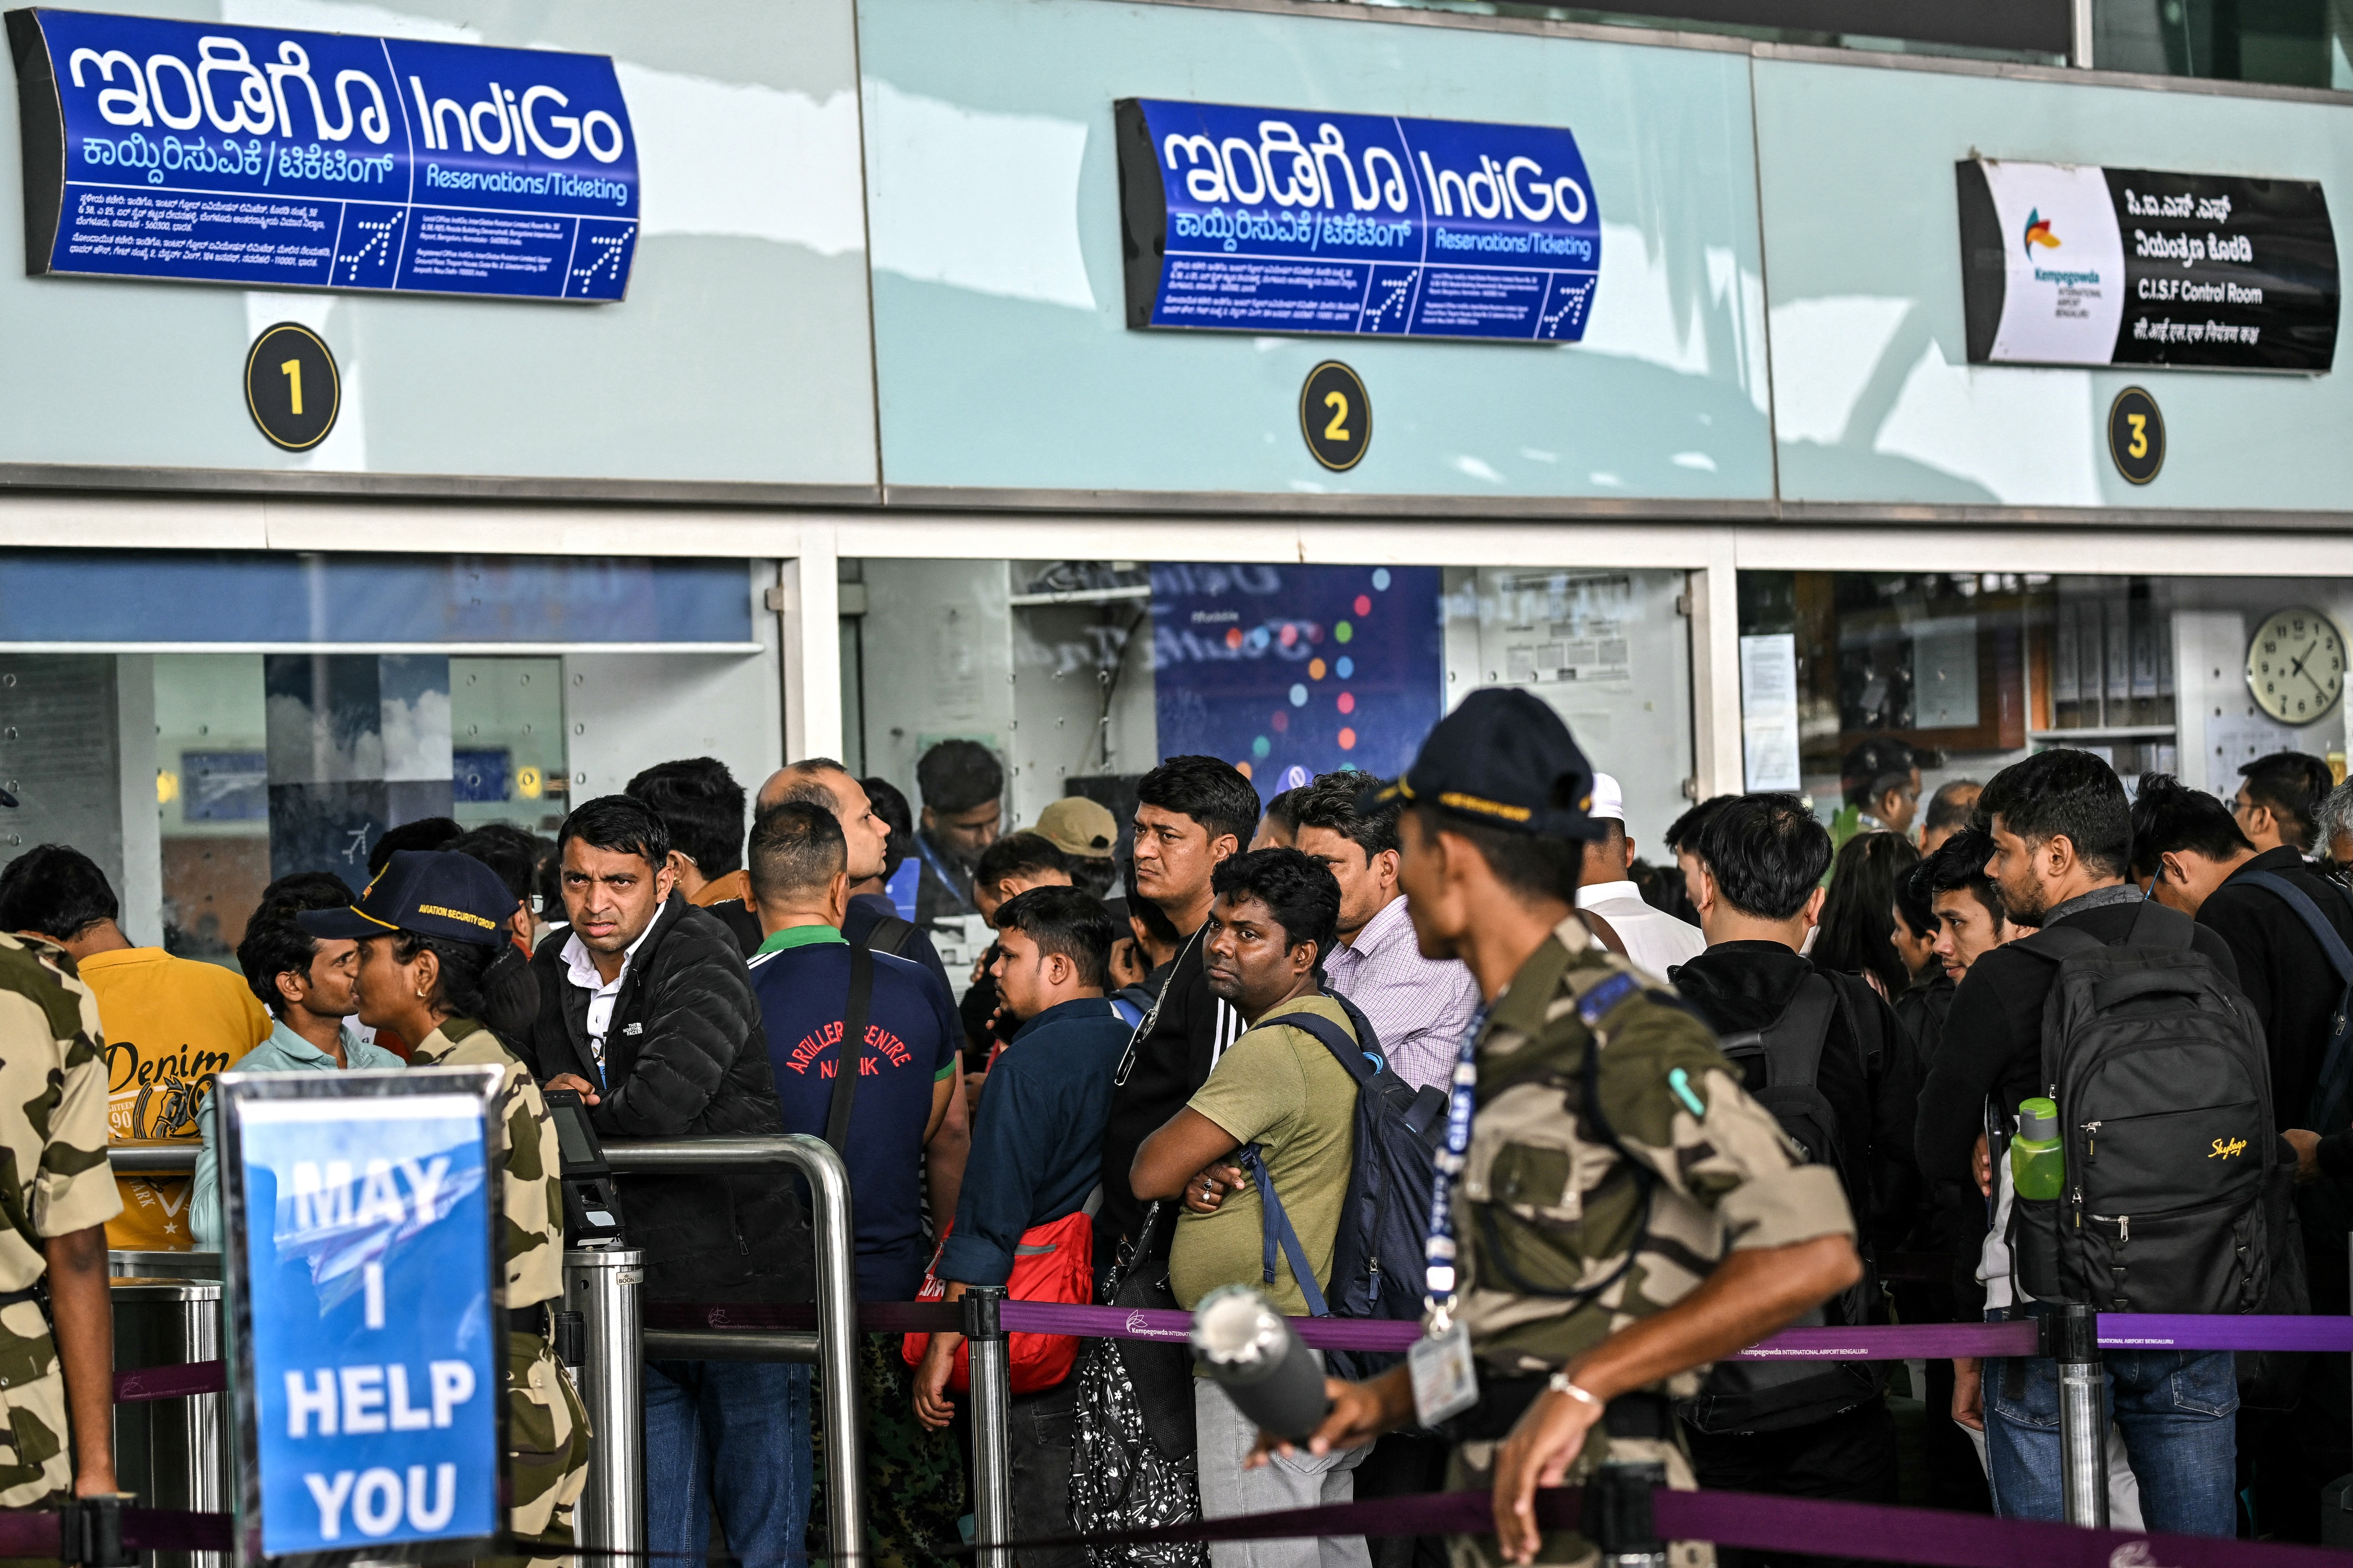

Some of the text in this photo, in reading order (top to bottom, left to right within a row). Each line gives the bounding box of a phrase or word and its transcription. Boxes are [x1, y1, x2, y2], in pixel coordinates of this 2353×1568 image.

[409, 75, 624, 162] IndiGo
[426, 162, 628, 205] Reservations/Ticketing
[1419, 151, 1588, 224] IndiGo
[1435, 228, 1592, 260] Reservations/Ticketing
[2034, 267, 2100, 288] Kempegowda
[2181, 280, 2225, 303] Control
[2227, 282, 2263, 304] Room
[281, 359, 303, 415] 1
[1324, 391, 1350, 441] 2
[2128, 413, 2148, 459] 3
[419, 904, 495, 930] AVIATION SECURITY GROUP
[106, 1042, 230, 1093] Denim
[786, 1021, 912, 1074] ARTILLER ENTRE
[820, 1057, 879, 1079] NIK
[2208, 1138, 2247, 1159] Skybags
[129, 1179, 155, 1208] ARK
[292, 1156, 450, 1228] MAY
[363, 1261, 385, 1329] I
[1132, 1328, 1168, 1336] Kempegowda
[284, 1359, 476, 1438] HELP
[304, 1462, 457, 1541] YOU
